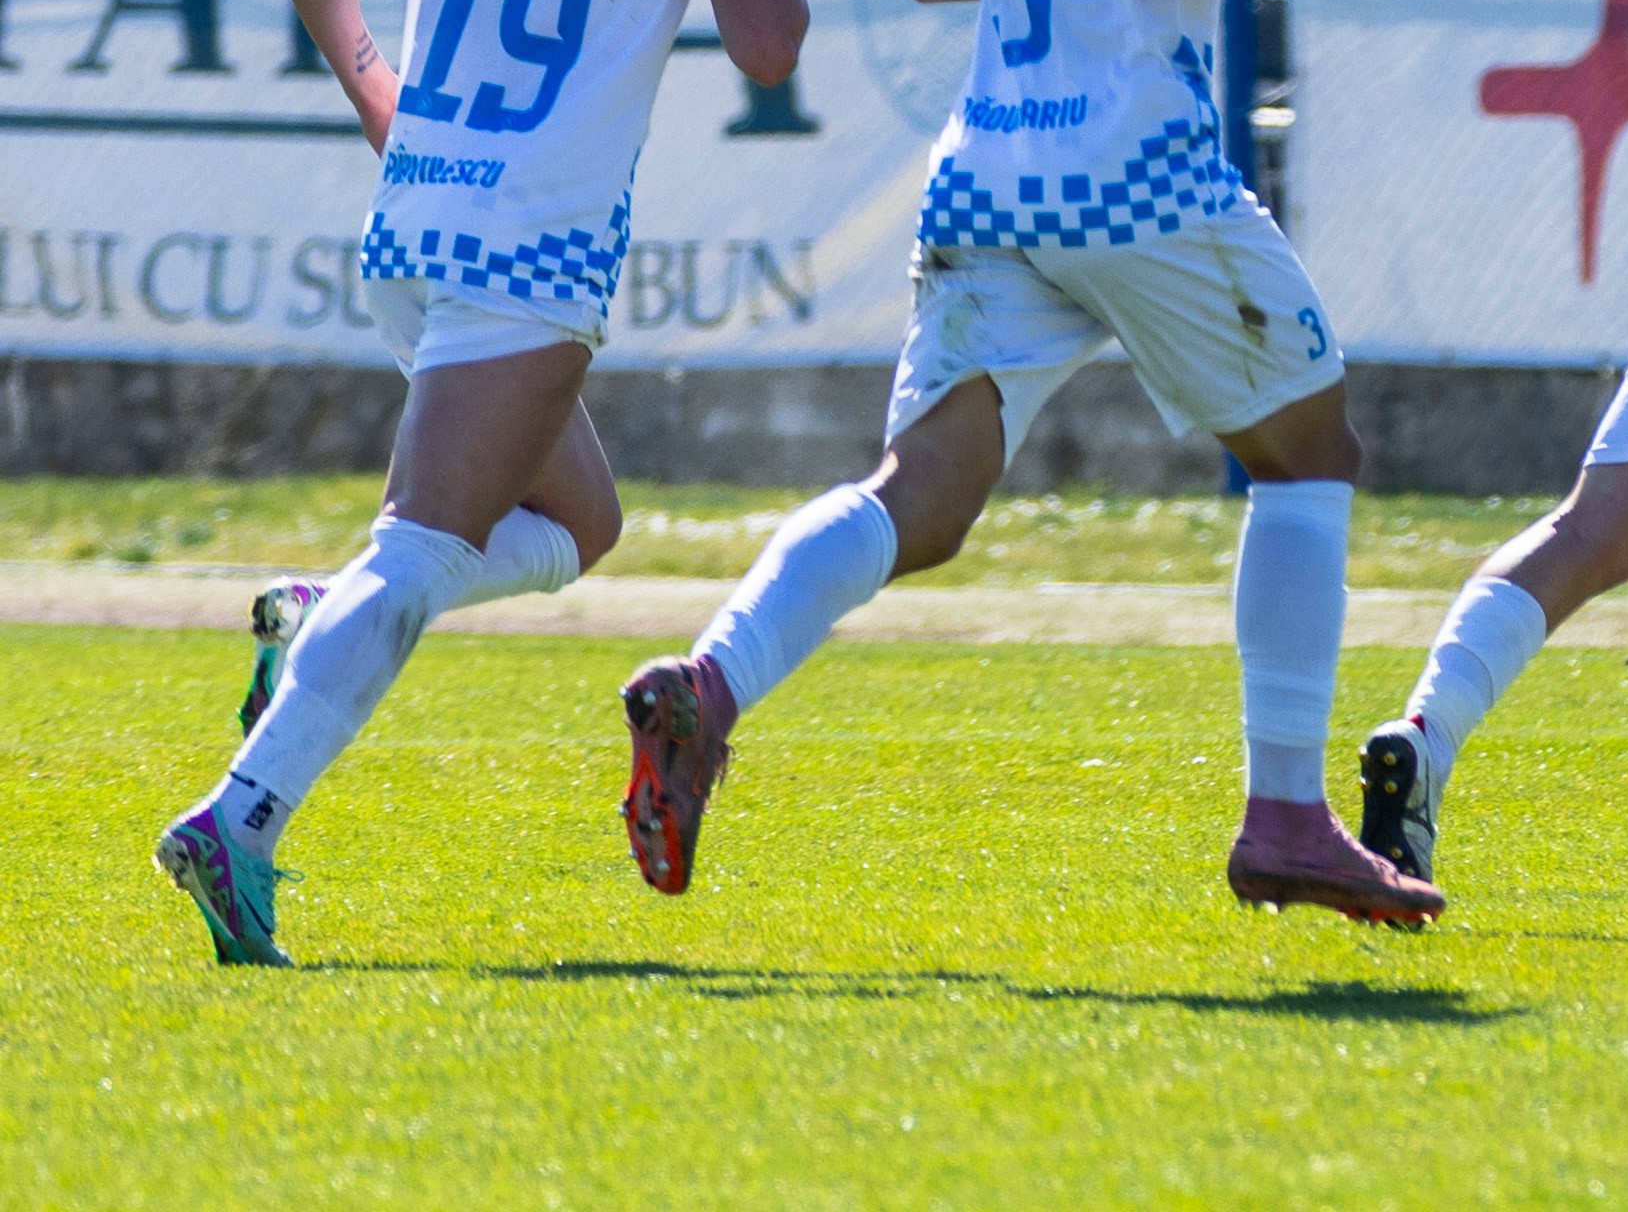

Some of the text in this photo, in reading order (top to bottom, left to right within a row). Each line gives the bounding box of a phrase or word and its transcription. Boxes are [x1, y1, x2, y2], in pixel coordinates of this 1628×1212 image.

[137, 231, 272, 326] CU
[627, 240, 818, 330] BUN
[1297, 306, 1328, 361] 3
